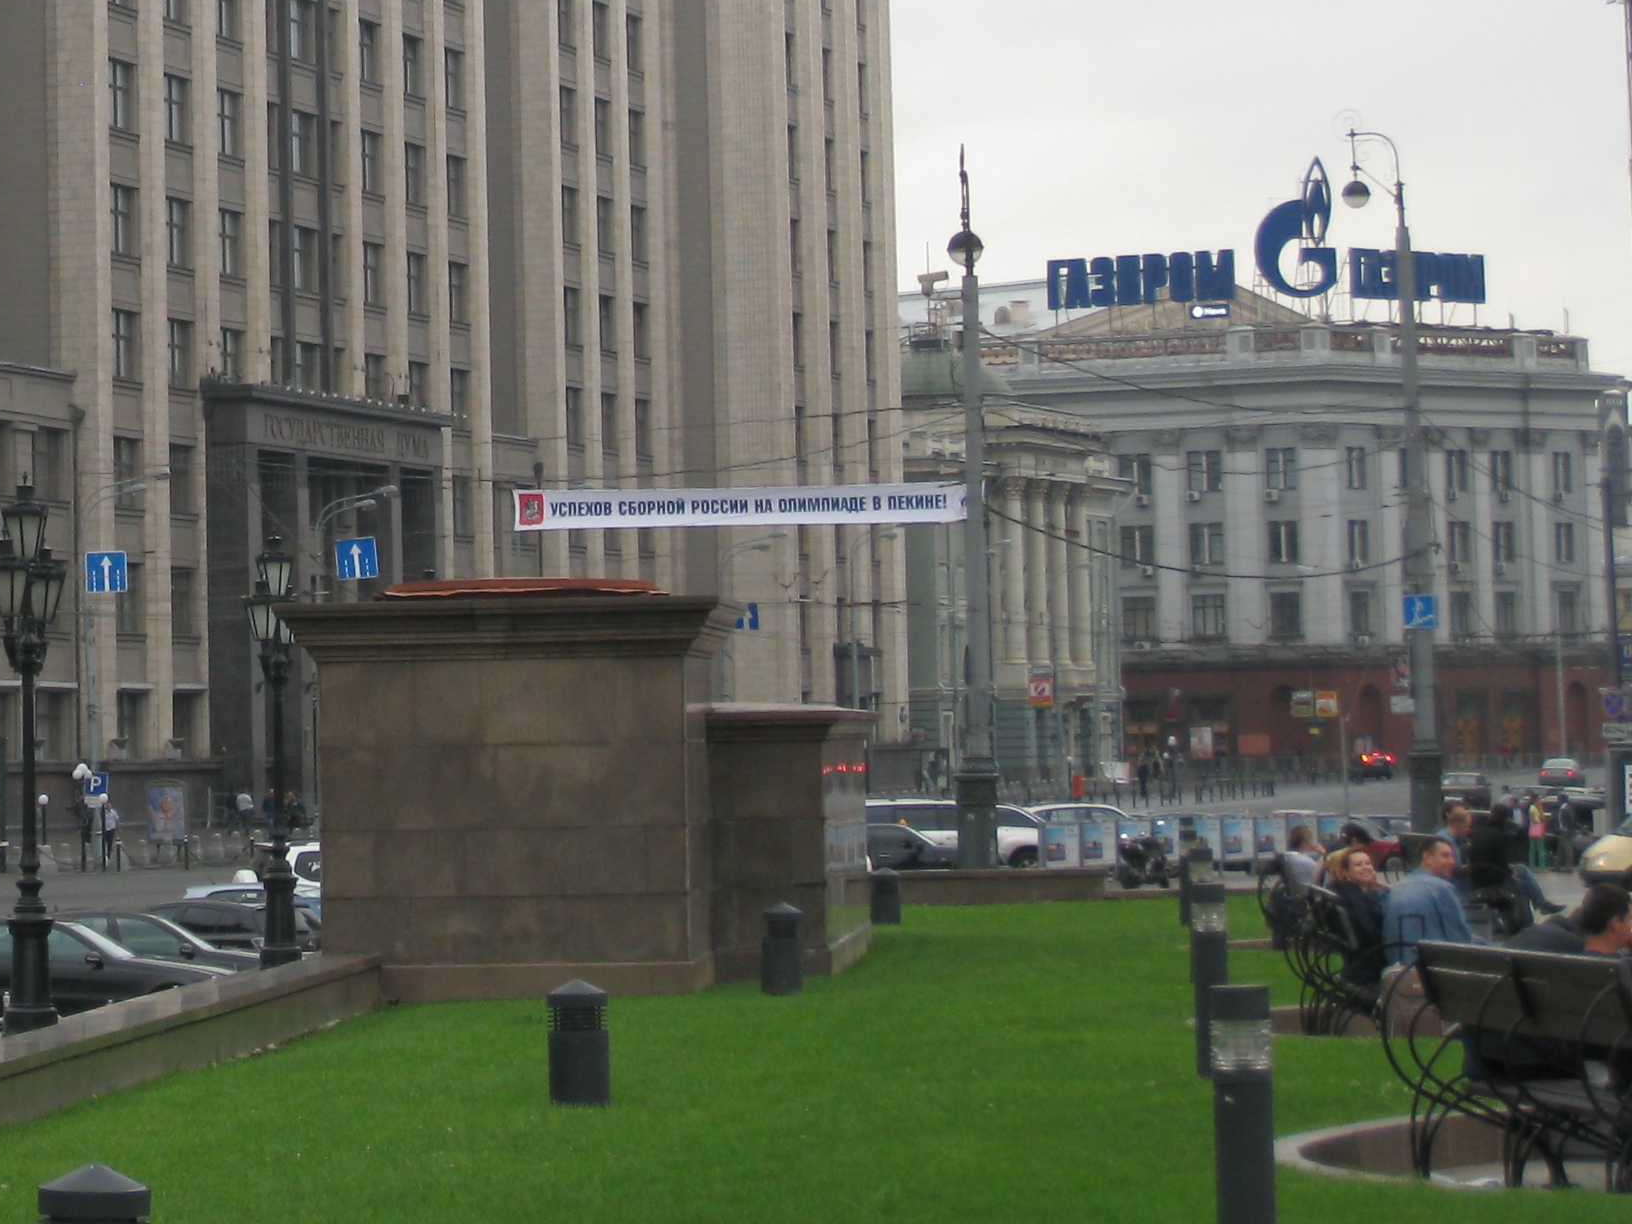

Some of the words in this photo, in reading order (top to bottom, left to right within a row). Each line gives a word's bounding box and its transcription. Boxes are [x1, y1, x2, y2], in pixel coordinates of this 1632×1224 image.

[1046, 248, 1236, 310] ГАЗПРОМ
[263, 412, 385, 455] ГОСУДАРСТВЕННАЯ
[396, 431, 430, 460] ДУМА
[550, 500, 612, 517] УСПЕХОВ
[618, 497, 685, 516] СБОРНОЙ
[691, 499, 749, 515] РОССИИ
[754, 498, 773, 514] НА
[778, 495, 867, 514] ОЛИМПИАДЕ
[872, 495, 882, 511] В
[887, 493, 947, 511] ПЕКИНЕ!
[90, 776, 102, 792] P
